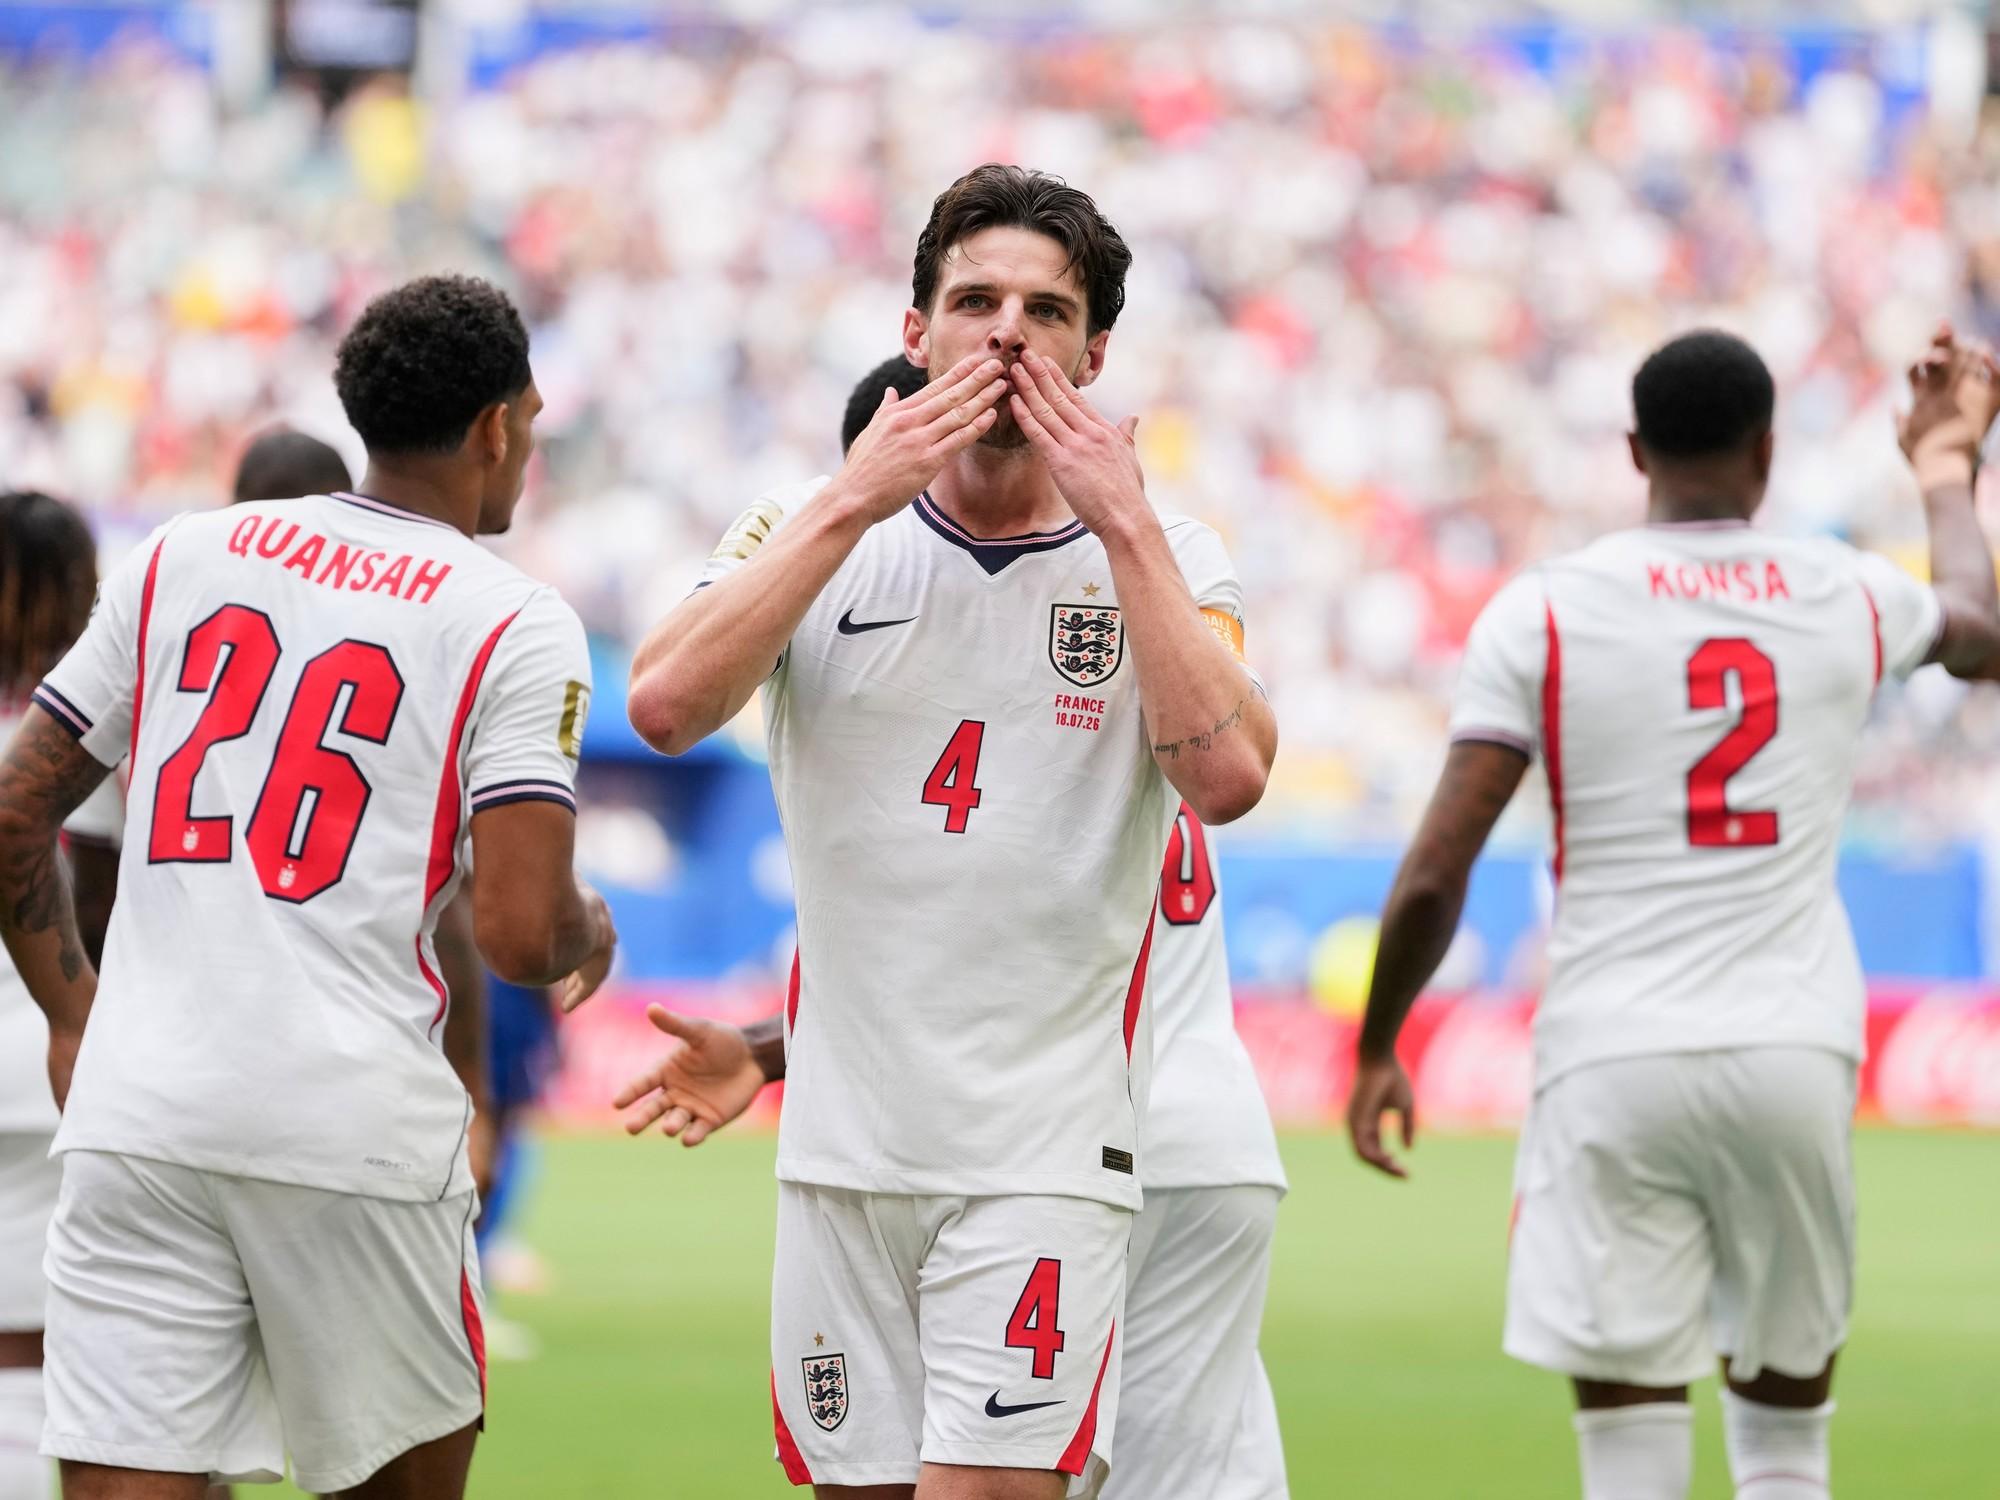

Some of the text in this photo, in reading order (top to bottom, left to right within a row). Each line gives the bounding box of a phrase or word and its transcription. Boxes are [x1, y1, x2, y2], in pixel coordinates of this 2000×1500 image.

[228, 515, 453, 604] QUANSAH
[148, 602, 406, 905] 26
[1055, 694, 1105, 714] FRANCE
[1056, 712, 1100, 731] 18.07.26
[1686, 637, 1779, 847] 2
[921, 719, 985, 834] 4
[1004, 1257, 1065, 1380] 4
